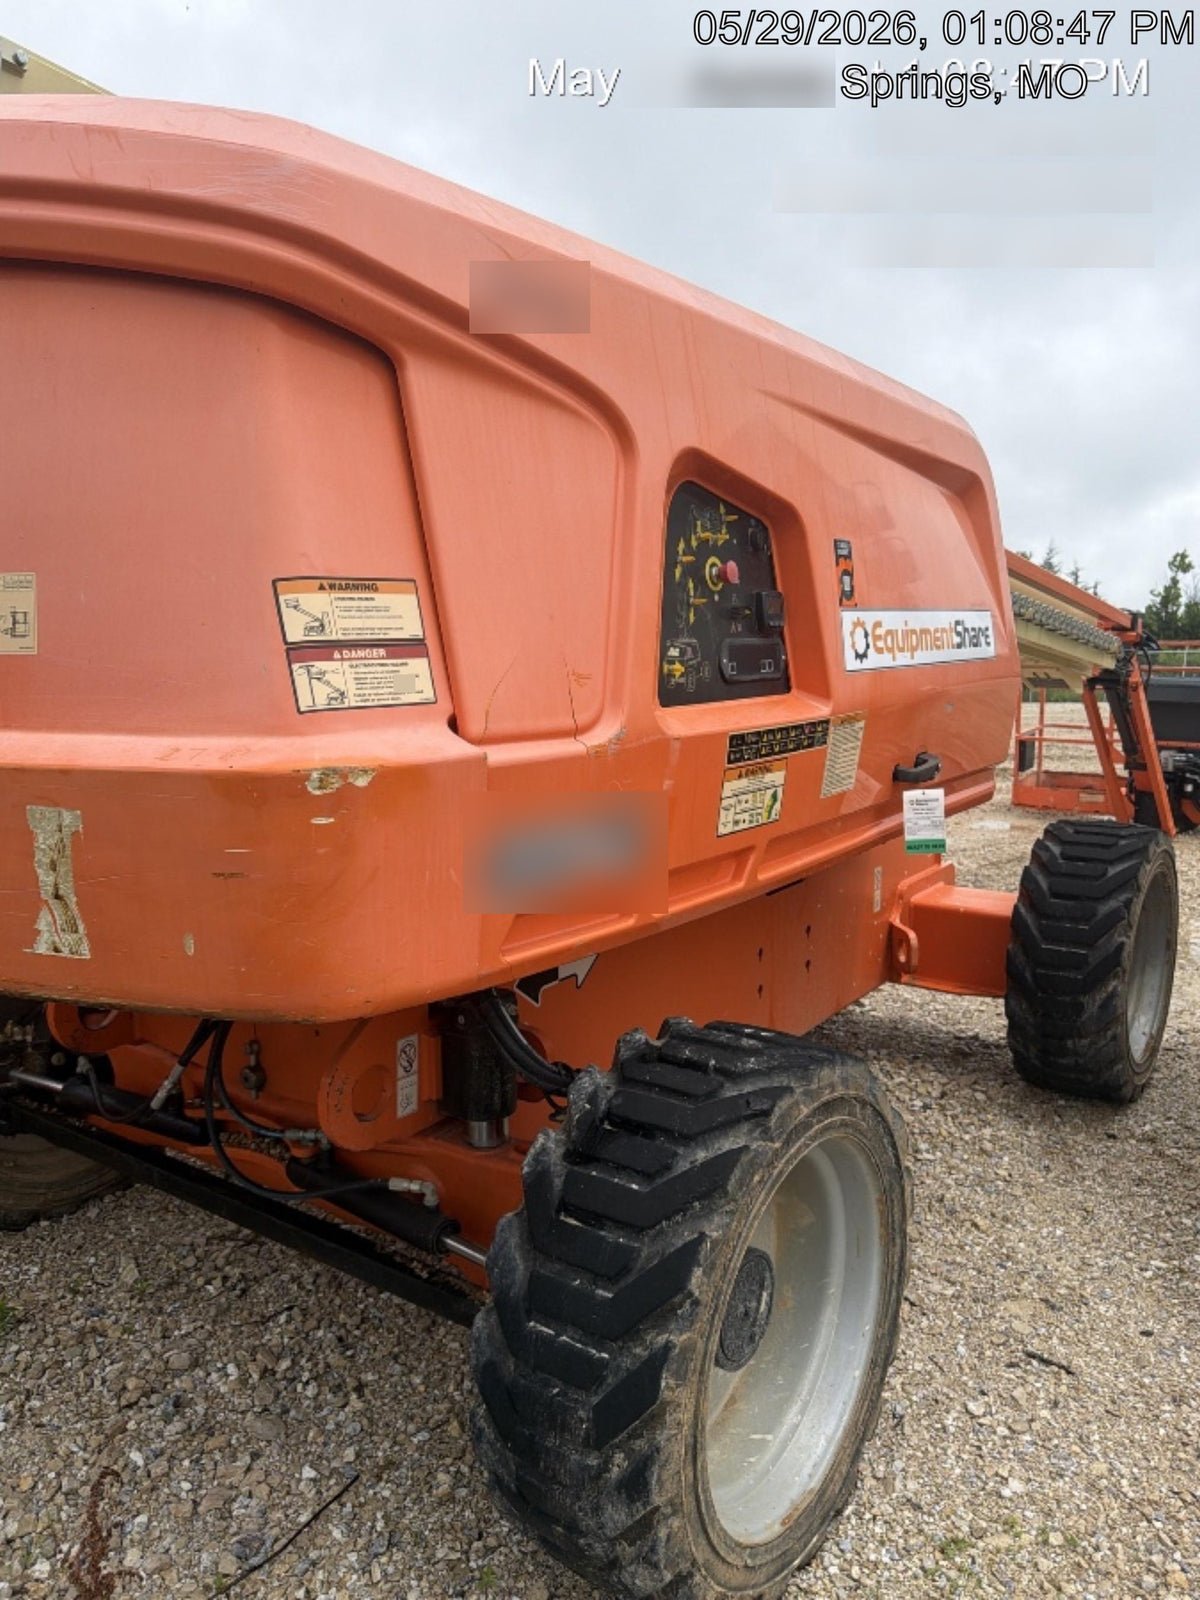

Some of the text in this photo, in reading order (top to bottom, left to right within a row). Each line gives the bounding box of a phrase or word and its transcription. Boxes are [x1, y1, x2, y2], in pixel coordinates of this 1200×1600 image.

[327, 582, 380, 593] WARNING
[871, 619, 991, 662] EquipmentShare
[342, 649, 387, 659] DANGER
